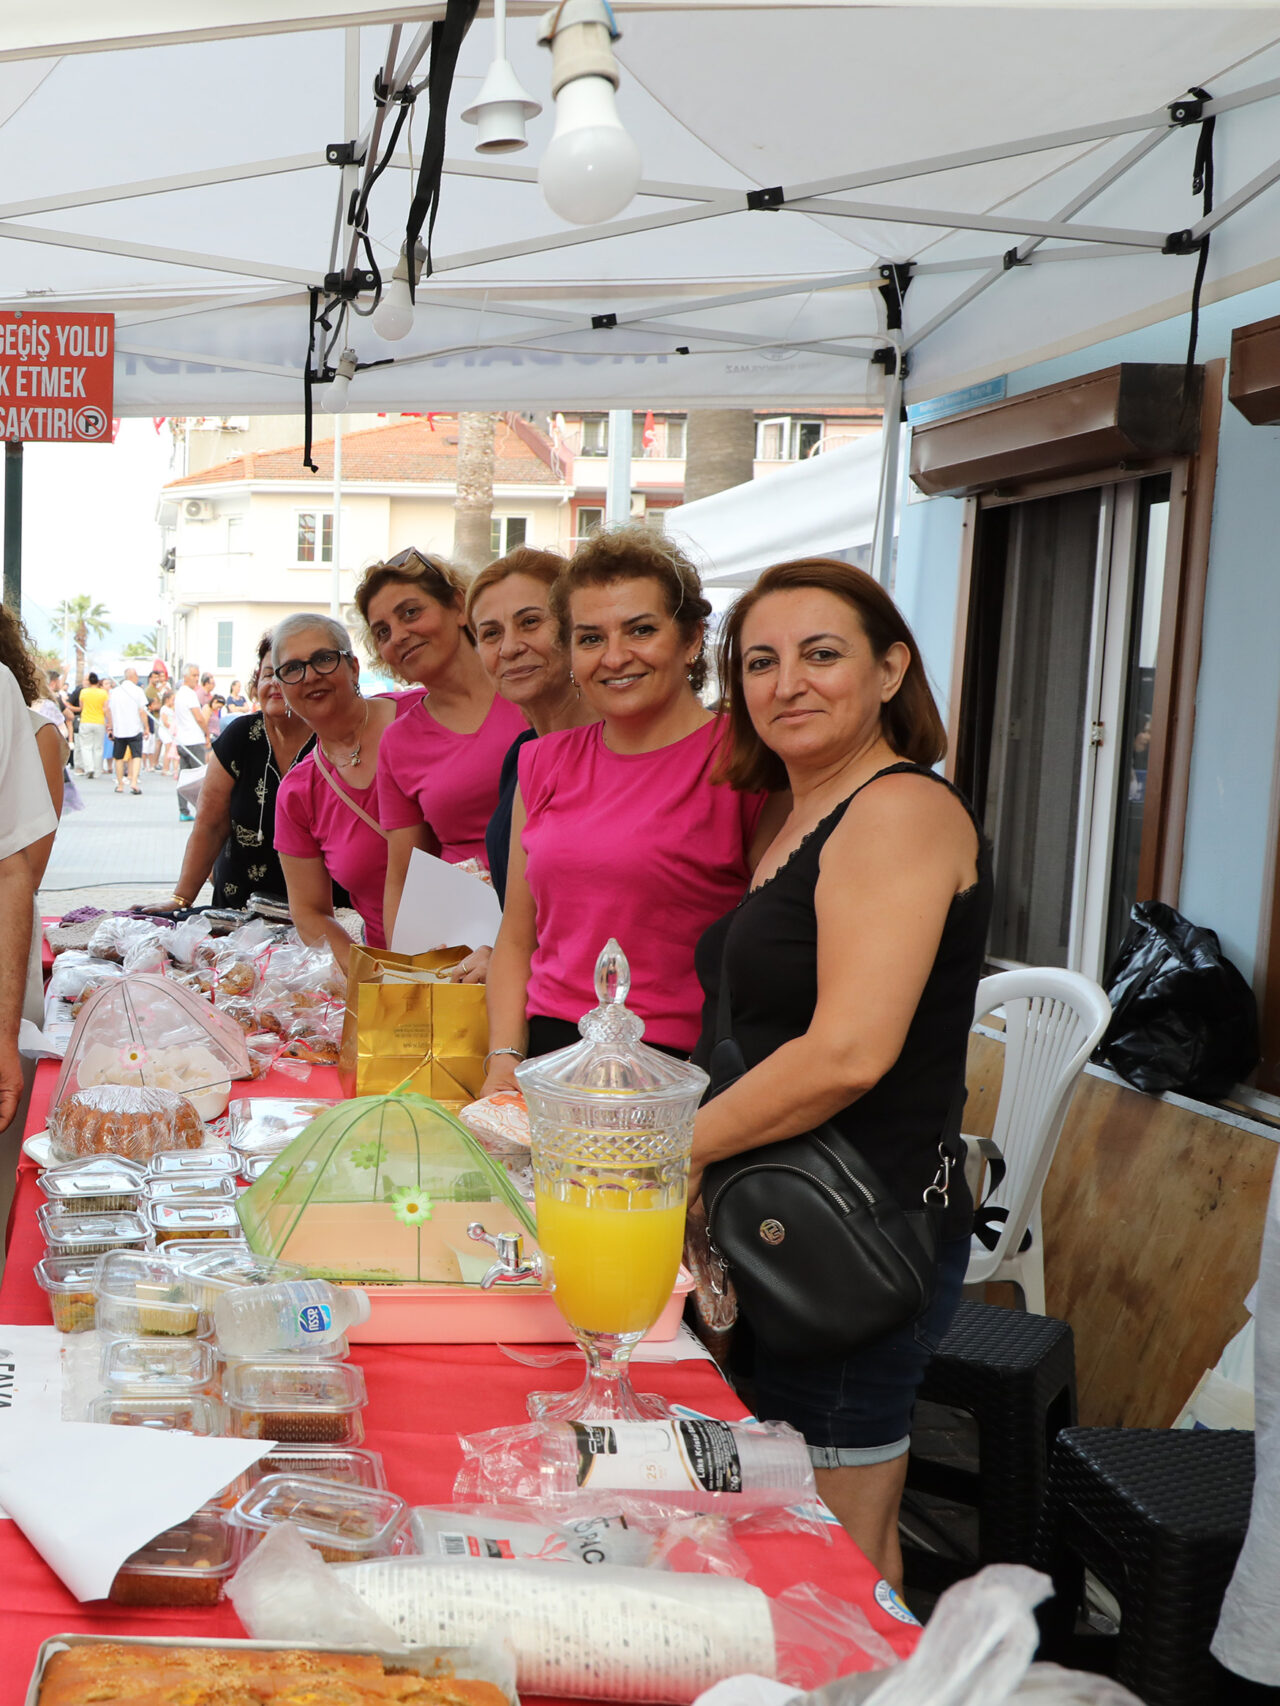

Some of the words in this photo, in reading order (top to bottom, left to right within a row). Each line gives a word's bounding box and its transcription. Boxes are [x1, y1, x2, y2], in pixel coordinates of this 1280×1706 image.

[55, 325, 109, 358] YOLU
[15, 365, 88, 398] ETMEK
[646, 1464, 657, 1480] 25
